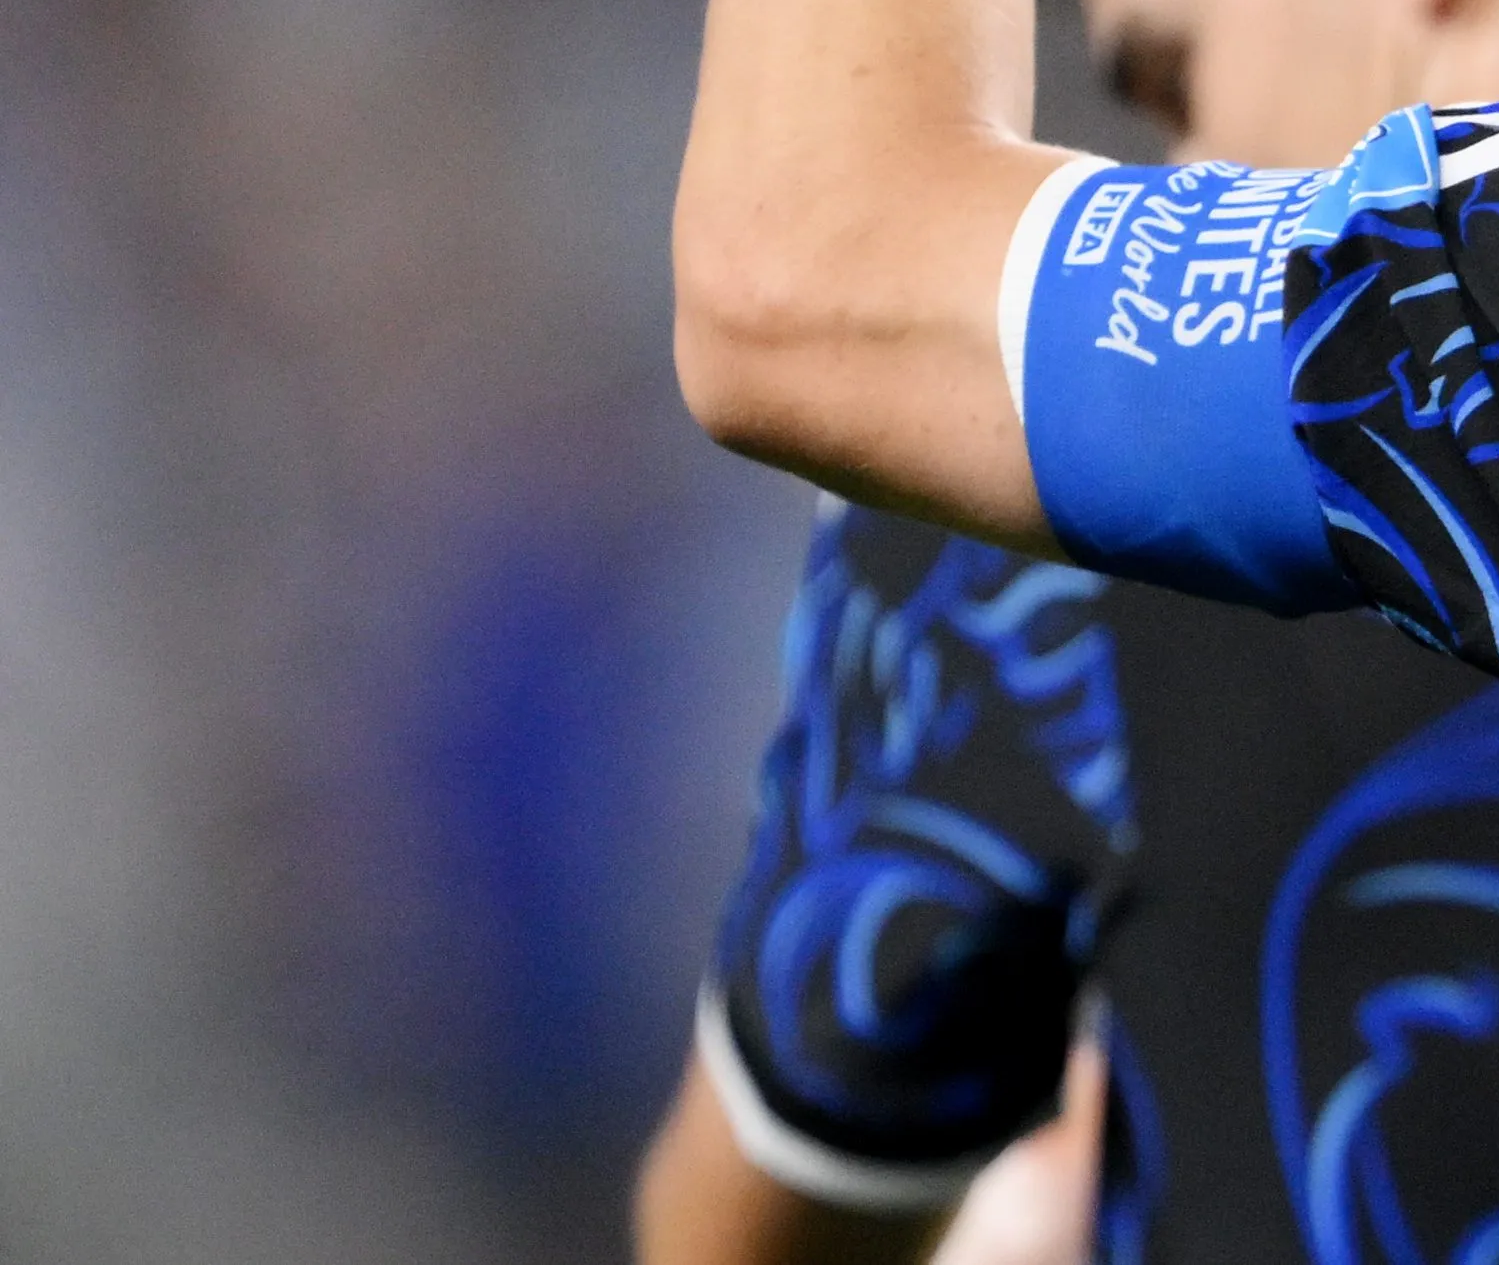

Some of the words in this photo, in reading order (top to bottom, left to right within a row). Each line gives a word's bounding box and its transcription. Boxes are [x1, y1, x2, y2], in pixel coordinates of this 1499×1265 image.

[1167, 160, 1246, 195] he
[1071, 189, 1130, 258] FIFA
[1095, 195, 1203, 366] World
